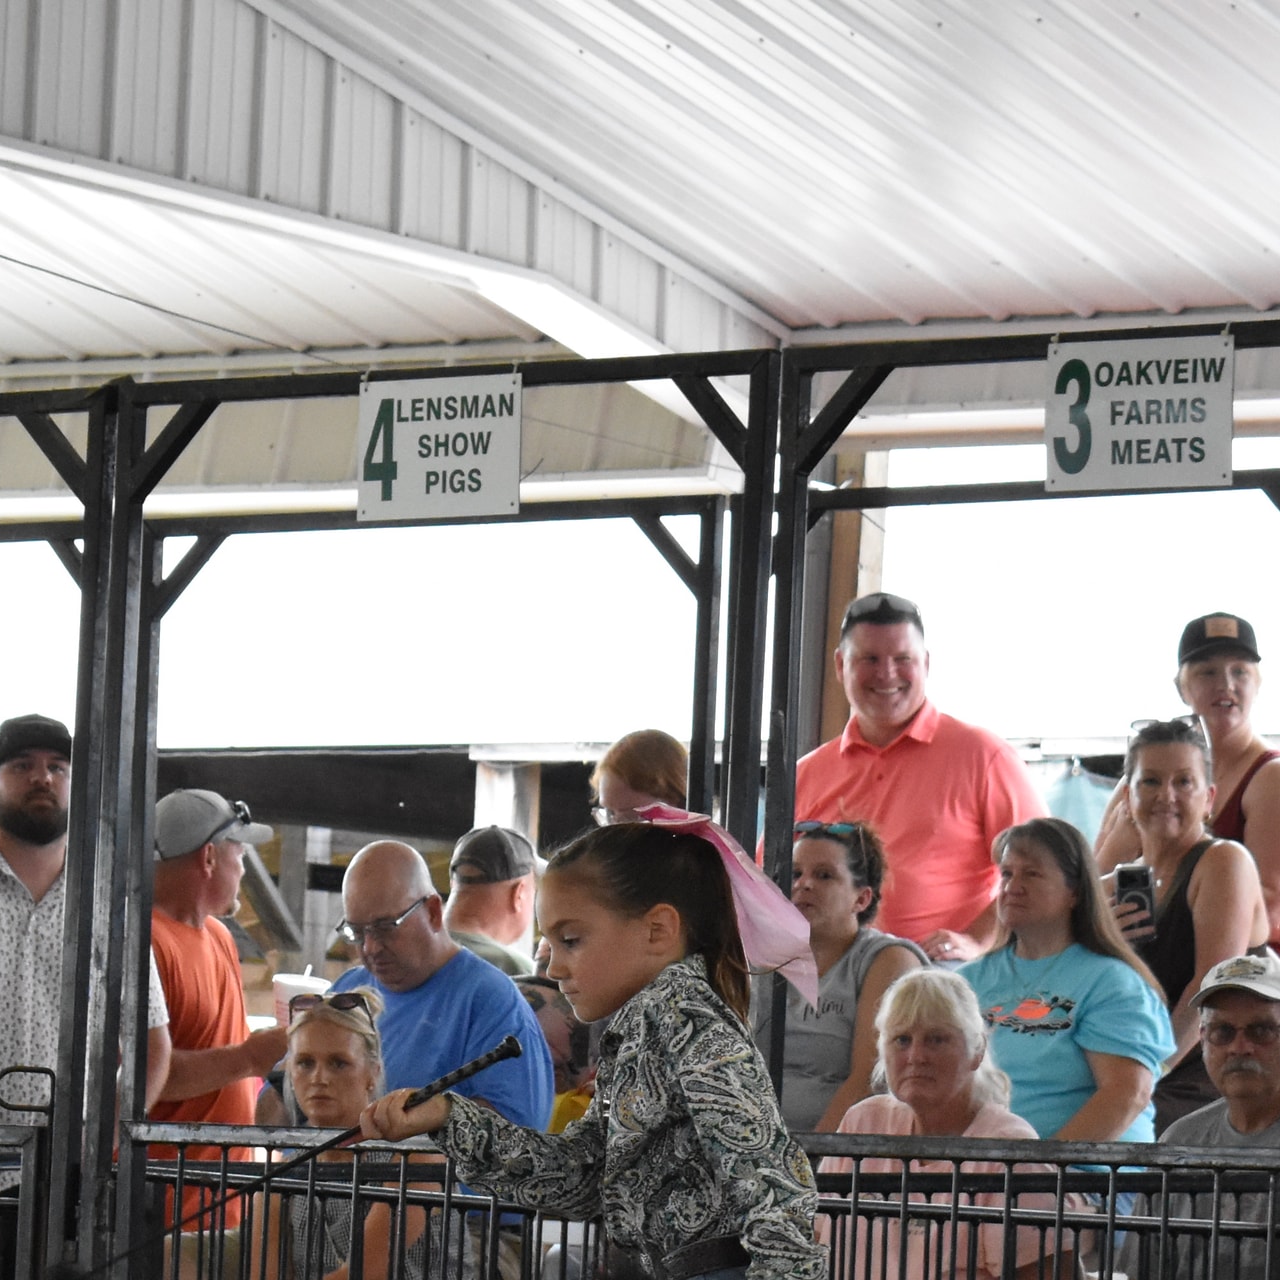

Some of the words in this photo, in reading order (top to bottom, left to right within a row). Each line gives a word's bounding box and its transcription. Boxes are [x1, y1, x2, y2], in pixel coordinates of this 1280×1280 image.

[1094, 357, 1226, 387] OAKVEIW
[396, 392, 514, 422] LENSMAN
[1053, 358, 1092, 475] 3
[1110, 397, 1207, 426] FARMS
[363, 398, 397, 502] 4
[418, 431, 492, 459] SHOW
[1111, 437, 1206, 465] MEATS
[425, 468, 482, 494] PIGS
